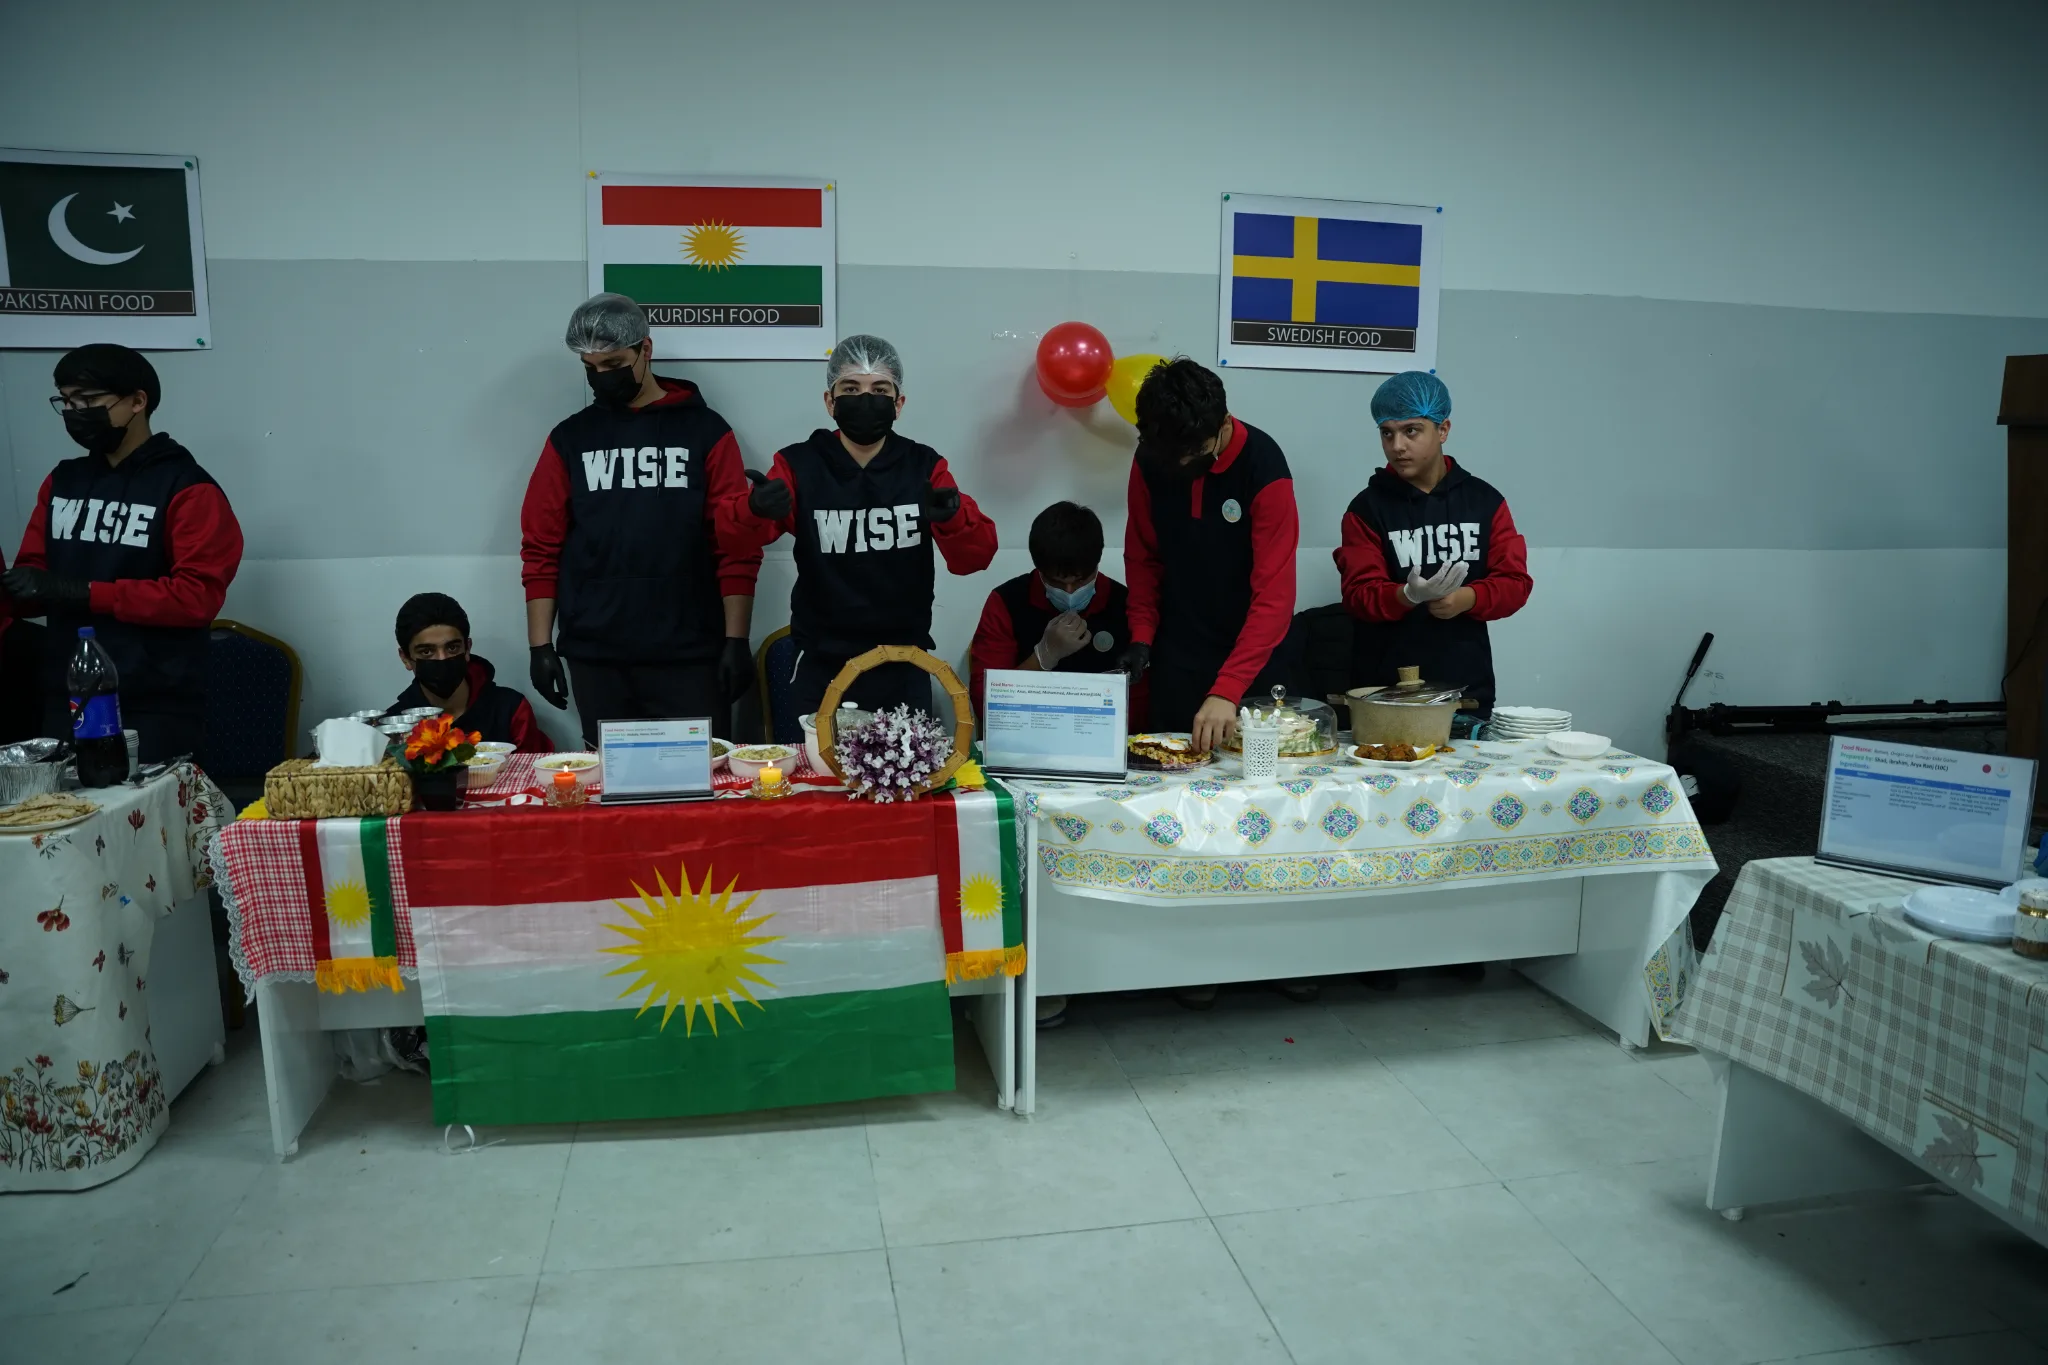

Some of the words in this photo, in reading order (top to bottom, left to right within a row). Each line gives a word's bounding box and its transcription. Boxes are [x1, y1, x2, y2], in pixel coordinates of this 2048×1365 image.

[100, 294, 155, 311] FOOD
[648, 308, 724, 324] KURDISH
[730, 308, 780, 324] FOOD
[1267, 326, 1335, 344] SWEDISH
[1338, 331, 1382, 346] FOOD
[581, 446, 690, 492] WISE
[51, 495, 157, 549] WISE
[813, 503, 922, 554] WISE
[1386, 522, 1481, 569] WISE
